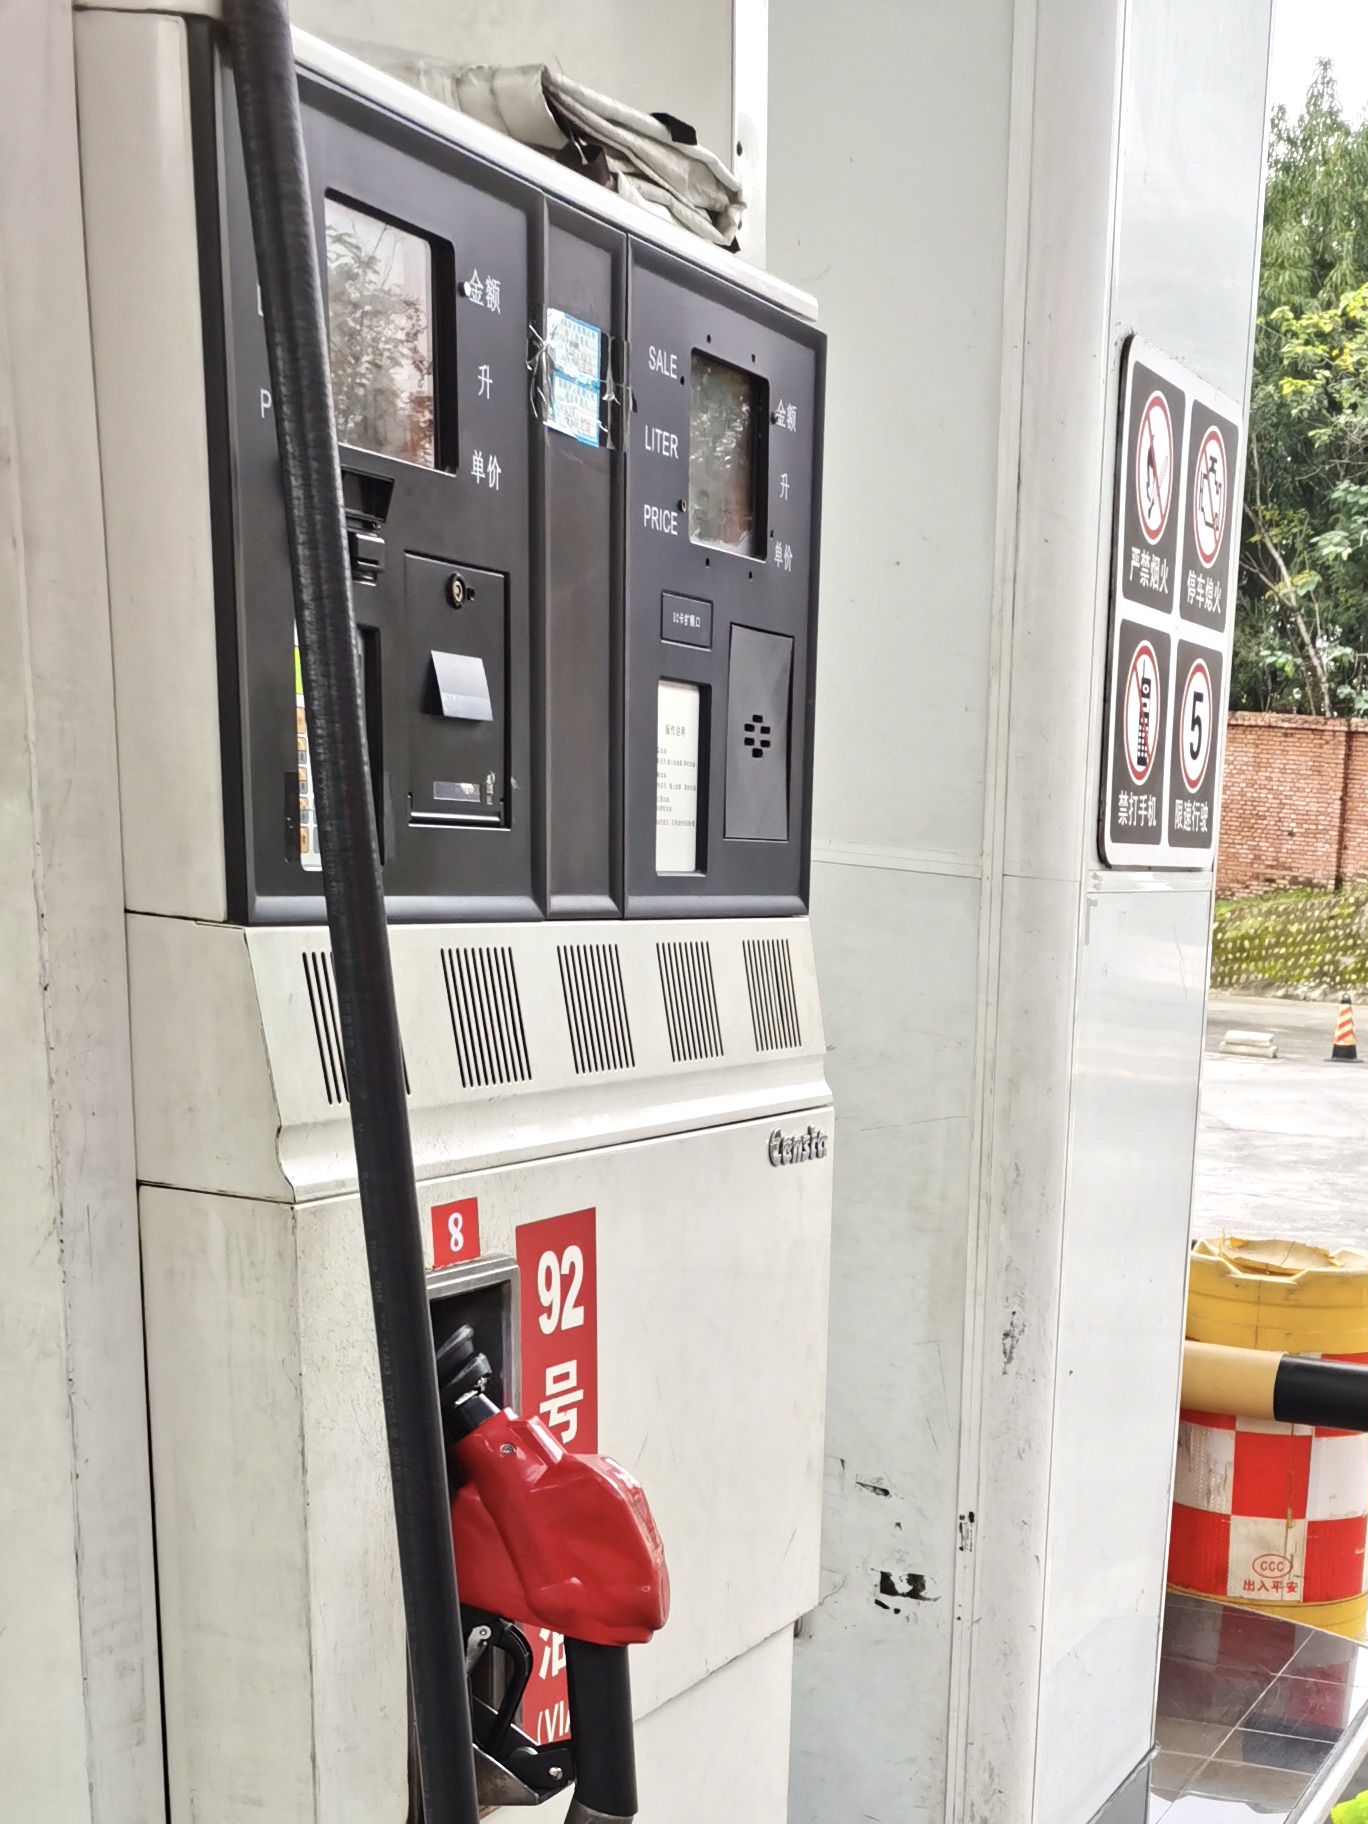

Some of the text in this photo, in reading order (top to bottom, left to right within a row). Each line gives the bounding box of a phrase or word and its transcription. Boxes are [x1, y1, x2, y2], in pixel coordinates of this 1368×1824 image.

[467, 268, 501, 315] 金额
[648, 345, 679, 380] SALE
[477, 364, 493, 400] 升
[775, 398, 798, 434] 金额
[644, 424, 680, 460] LITER
[470, 449, 502, 491] 单价
[779, 472, 790, 501] 升
[643, 503, 679, 536] PRICE
[773, 541, 794, 573] 单价
[1129, 546, 1169, 596] 严禁烟火
[1187, 569, 1223, 615] 停车熄火
[1189, 690, 1204, 761] 5
[1117, 790, 1157, 828] 禁打手机
[1174, 799, 1209, 833] 限速行驶
[447, 1212, 465, 1252] 8
[537, 1245, 585, 1335] 92
[1260, 1560, 1284, 1572] CCC
[1242, 1579, 1299, 1594] 出入平安
